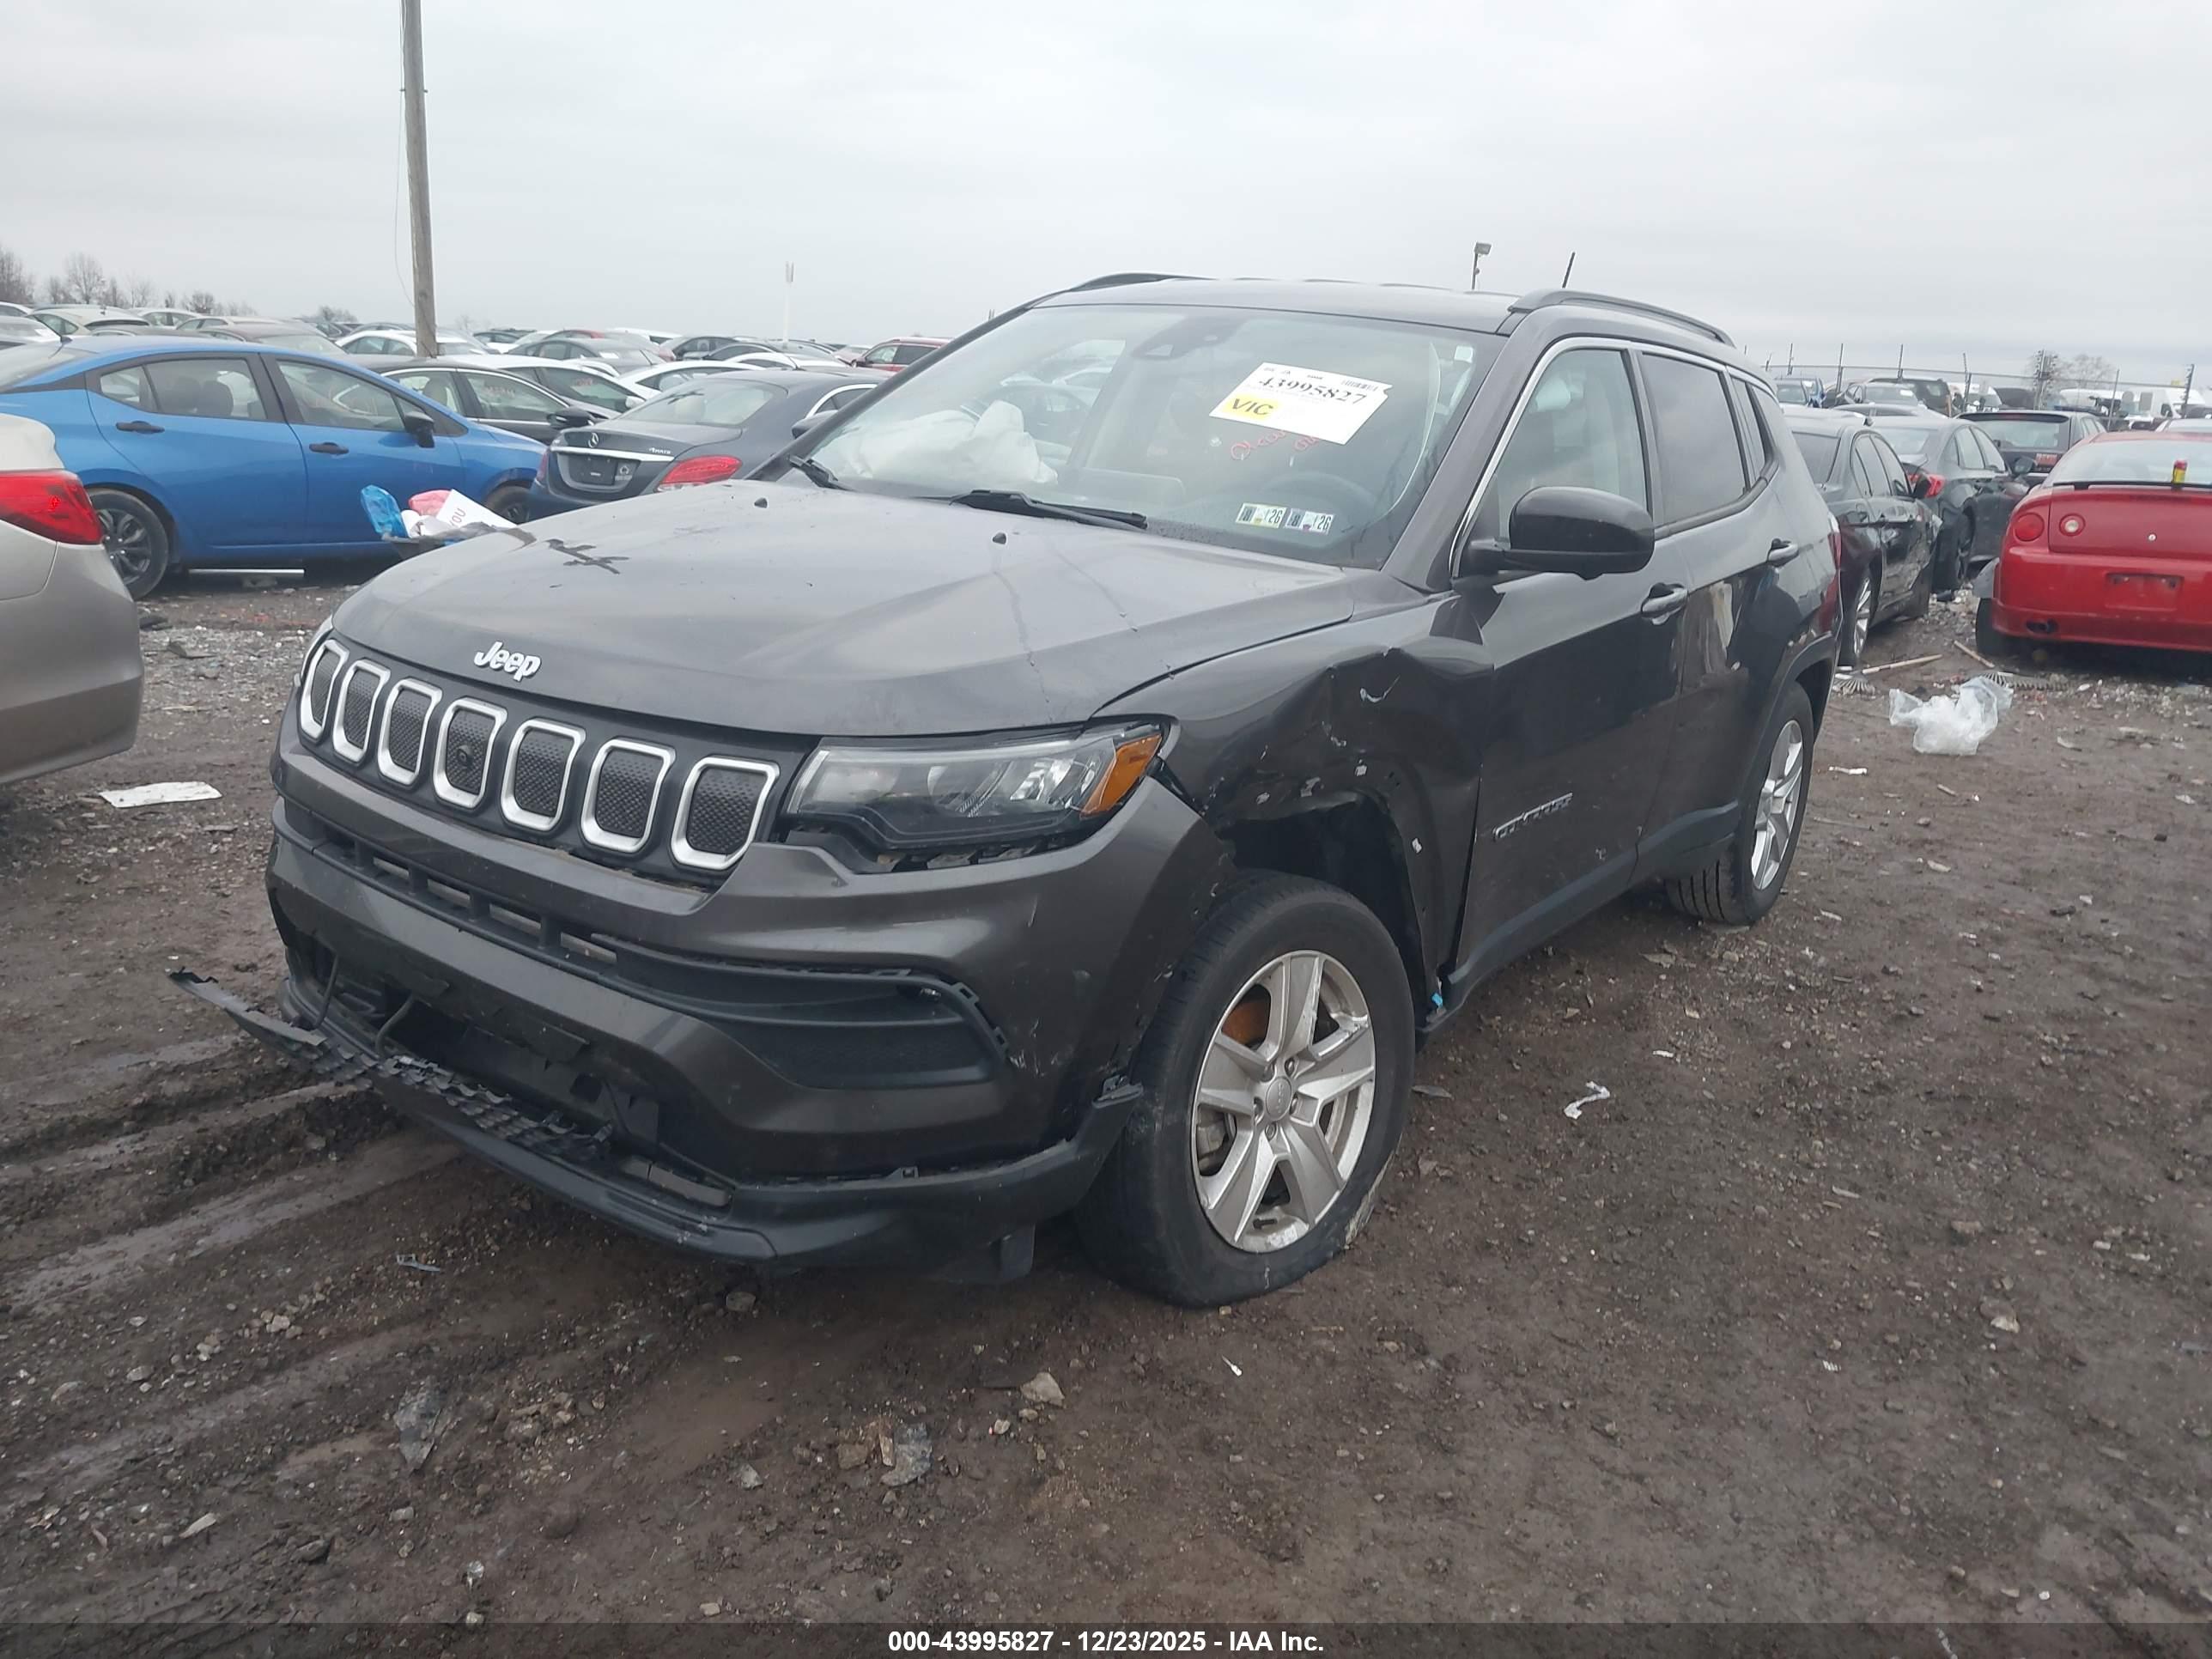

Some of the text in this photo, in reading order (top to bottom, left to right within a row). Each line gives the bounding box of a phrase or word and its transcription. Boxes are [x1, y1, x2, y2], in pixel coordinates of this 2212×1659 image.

[1259, 377, 1367, 404] 43995827
[1231, 398, 1274, 416] VIC
[1268, 509, 1283, 524] 26
[1316, 515, 1332, 531] 26
[473, 641, 542, 682] Jeep
